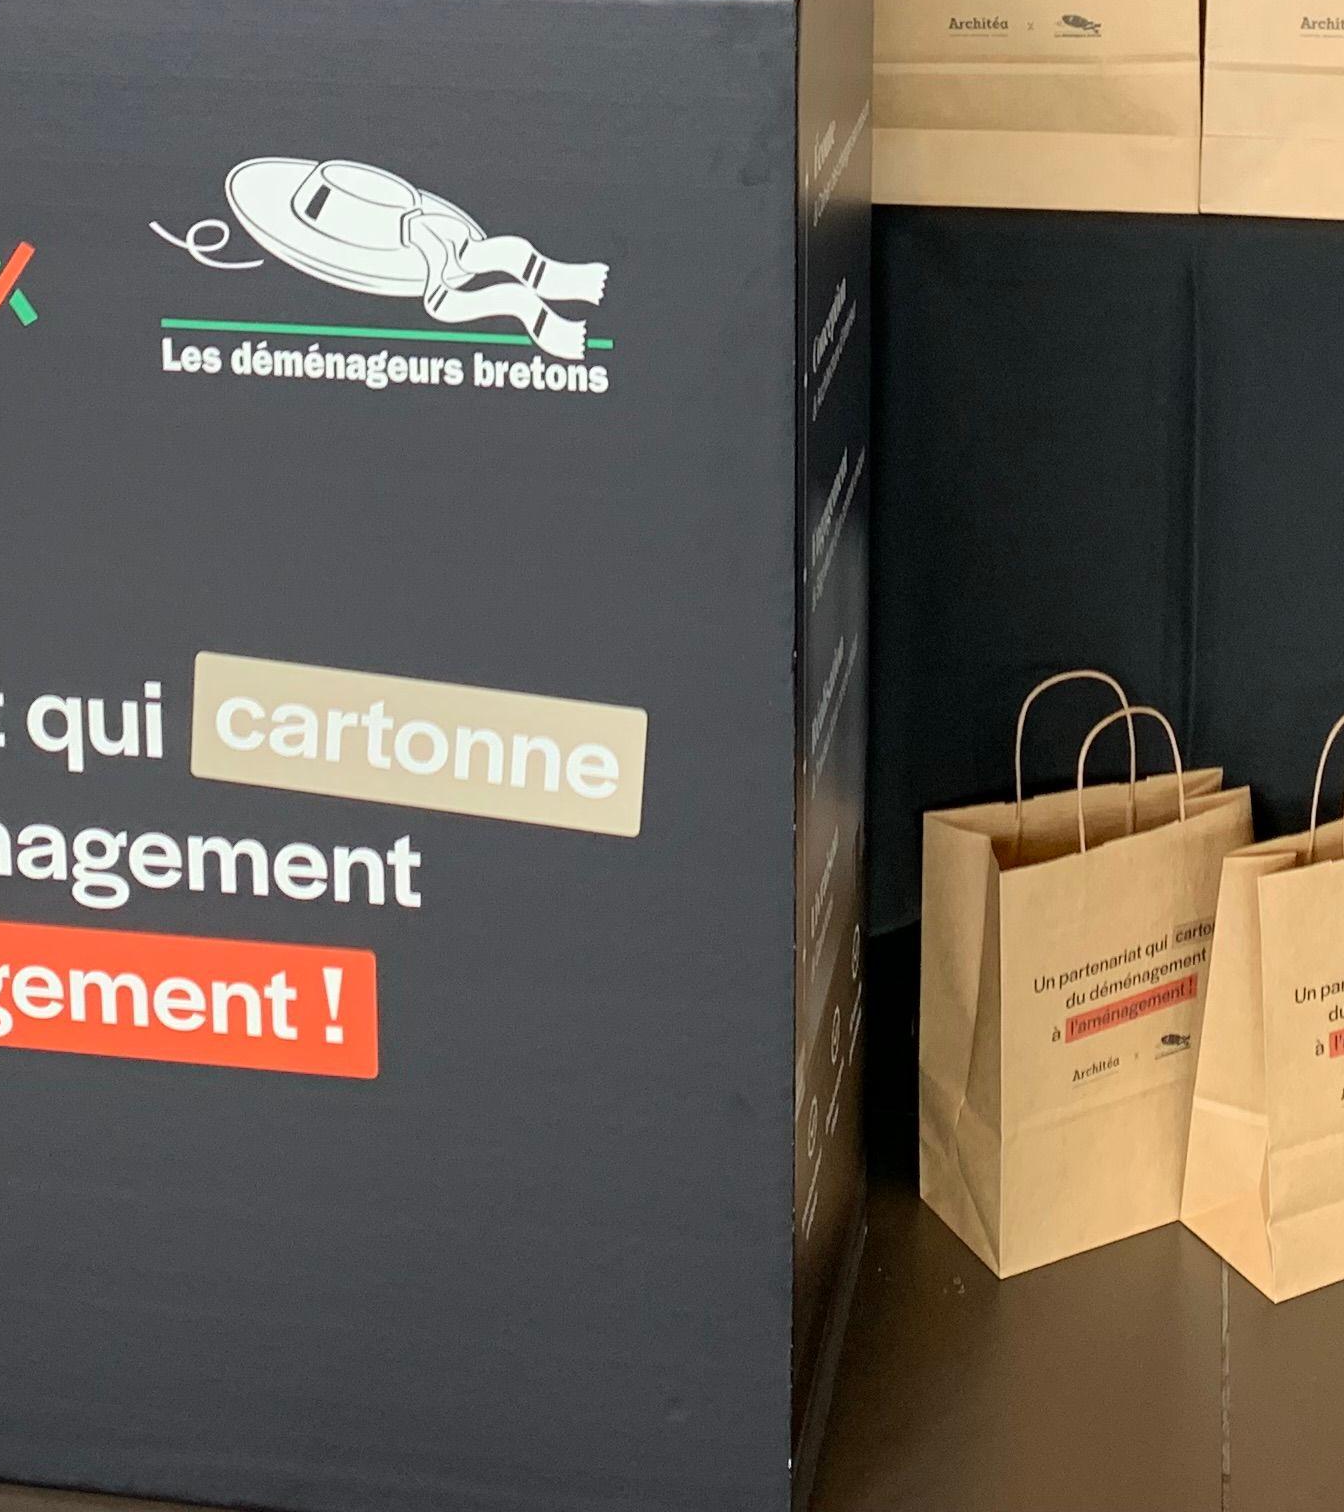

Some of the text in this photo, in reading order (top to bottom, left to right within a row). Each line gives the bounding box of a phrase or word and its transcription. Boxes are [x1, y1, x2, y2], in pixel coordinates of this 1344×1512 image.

[948, 15, 1009, 31] Architéa
[162, 337, 610, 395] Les déménageurs bretons
[26, 681, 165, 772] qui
[214, 691, 621, 800] cartonne
[1033, 922, 1215, 995] Un partenariat qui carto
[1065, 948, 1208, 1010] du déménagement
[321, 966, 342, 1045] !
[1051, 1025, 1062, 1043] à
[1069, 983, 1186, 1039] l'aménagement
[1294, 985, 1318, 1004] Un
[1071, 1054, 1120, 1084] Architéa
[1314, 1039, 1325, 1057] à
